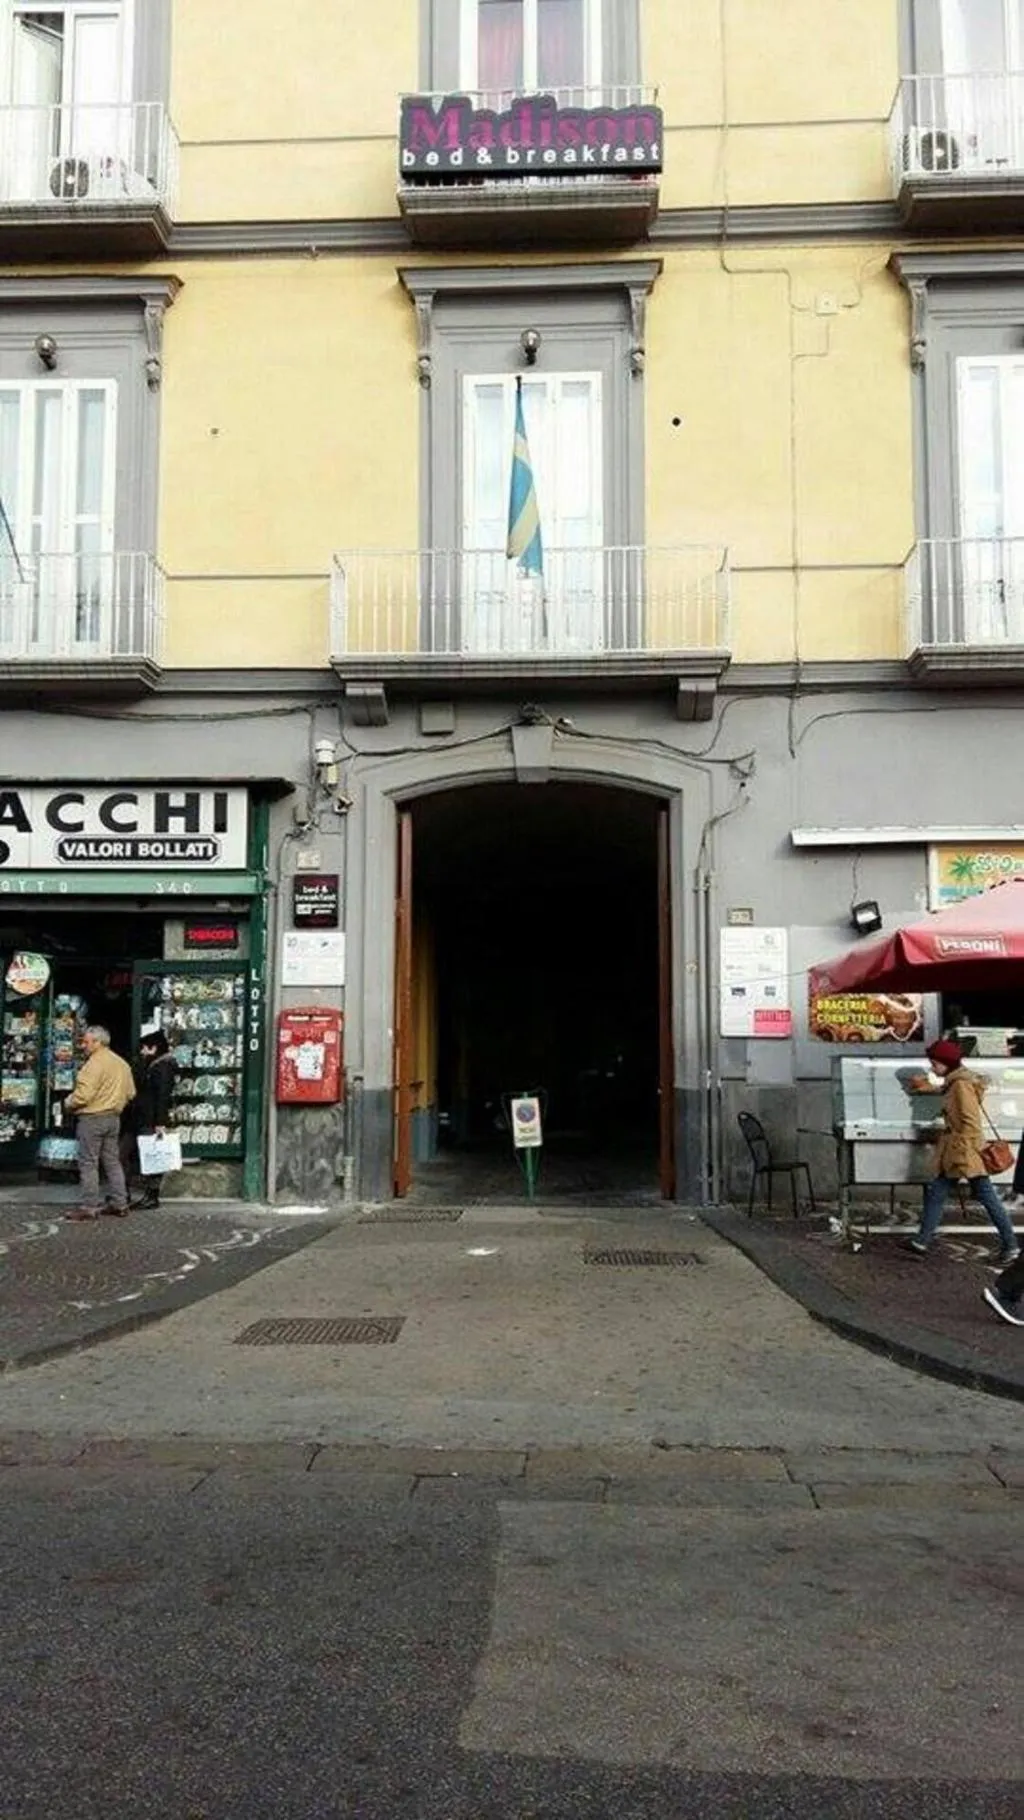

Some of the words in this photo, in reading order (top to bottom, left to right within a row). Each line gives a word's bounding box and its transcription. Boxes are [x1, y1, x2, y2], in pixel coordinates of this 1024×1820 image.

[407, 103, 656, 149] Madison
[402, 148, 463, 166] bed
[476, 147, 492, 165] &
[506, 142, 659, 164] breakfast
[63, 843, 131, 857] VALORI
[138, 843, 214, 857] BOLLATI
[249, 968, 260, 1051] LOTTO
